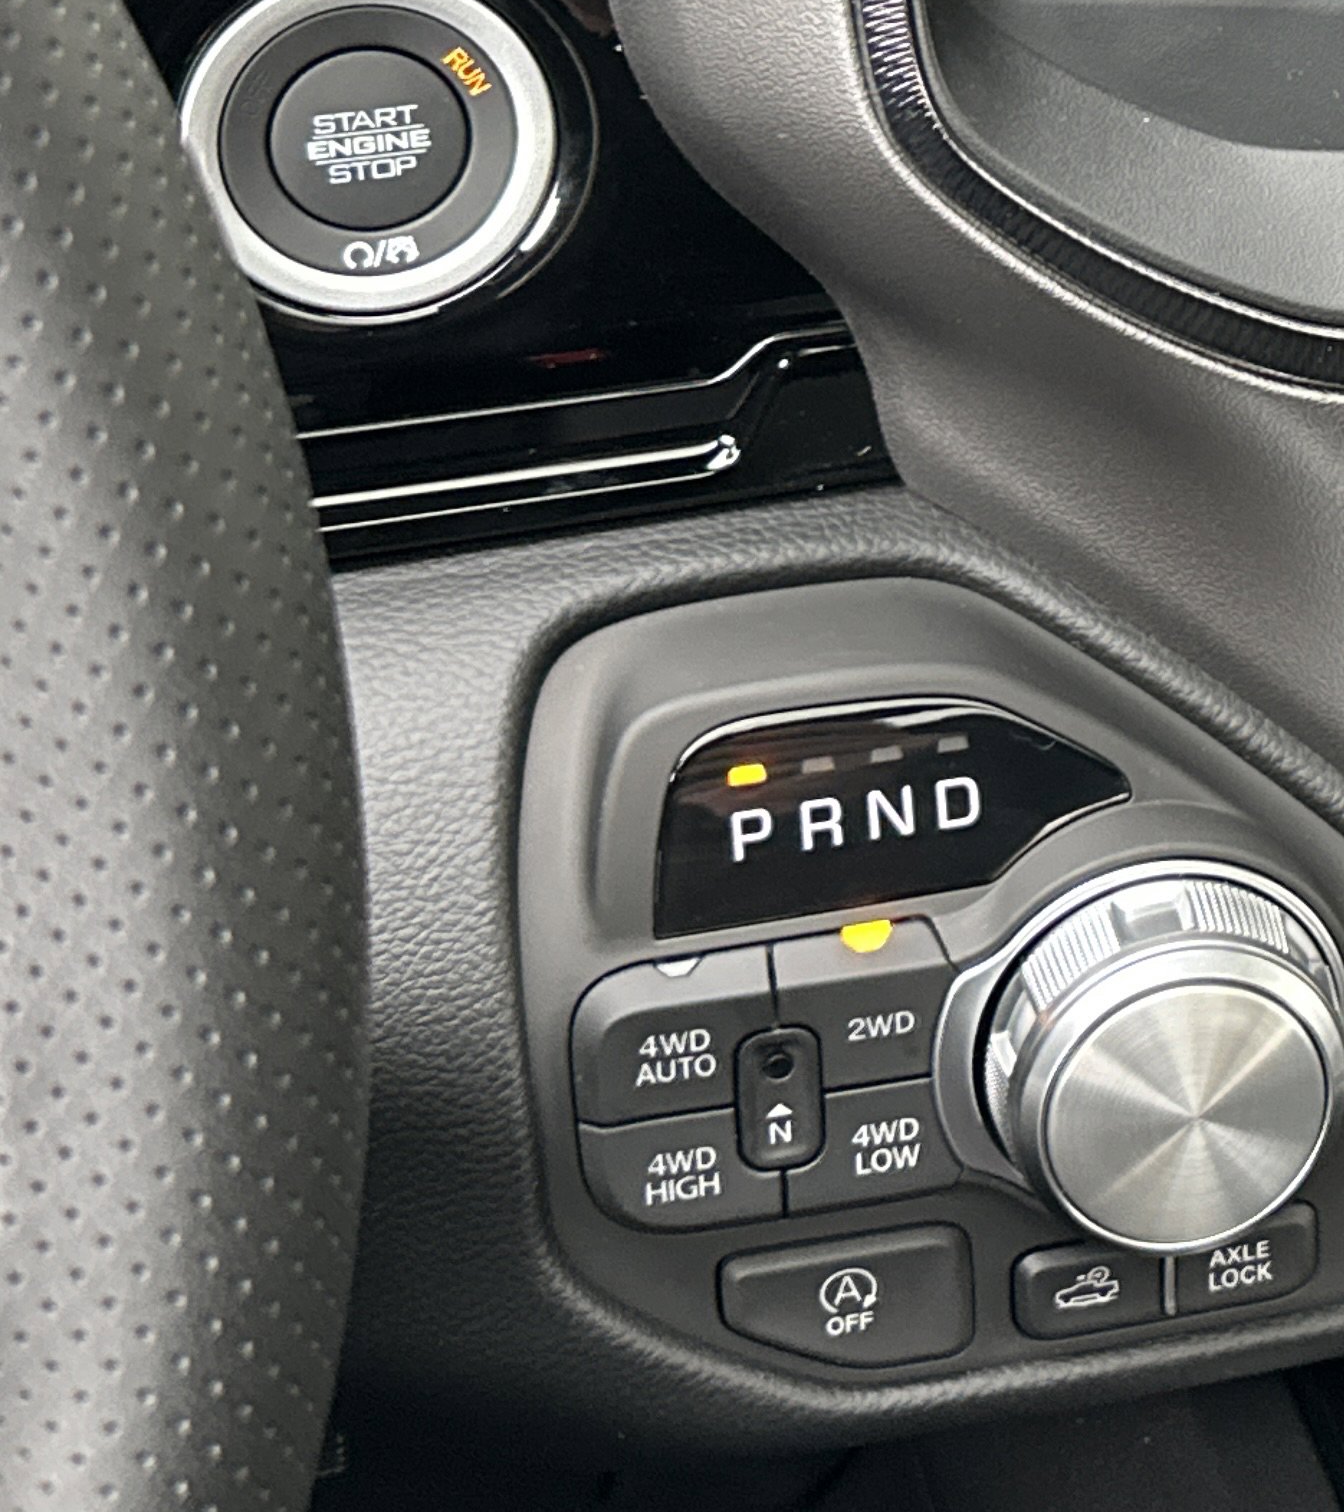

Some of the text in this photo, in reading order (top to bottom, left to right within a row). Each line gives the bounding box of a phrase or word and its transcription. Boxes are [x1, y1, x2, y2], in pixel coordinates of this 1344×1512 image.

[441, 46, 493, 98] RUN
[312, 104, 419, 134] START
[307, 128, 432, 161] ENGINE
[328, 154, 417, 184] STOP
[729, 777, 982, 862] P R N D
[847, 1011, 916, 1041] 2WD
[639, 1028, 711, 1056] 4WD
[635, 1054, 717, 1088] AUTO
[768, 1121, 793, 1145] N
[851, 1117, 920, 1146] 4WD
[648, 1147, 717, 1175] 4WD
[855, 1144, 922, 1176] LOW
[644, 1171, 722, 1206] HIGH
[1209, 1240, 1270, 1268] AXLE
[1209, 1261, 1273, 1292] LOCK
[825, 1312, 875, 1337] OFF
